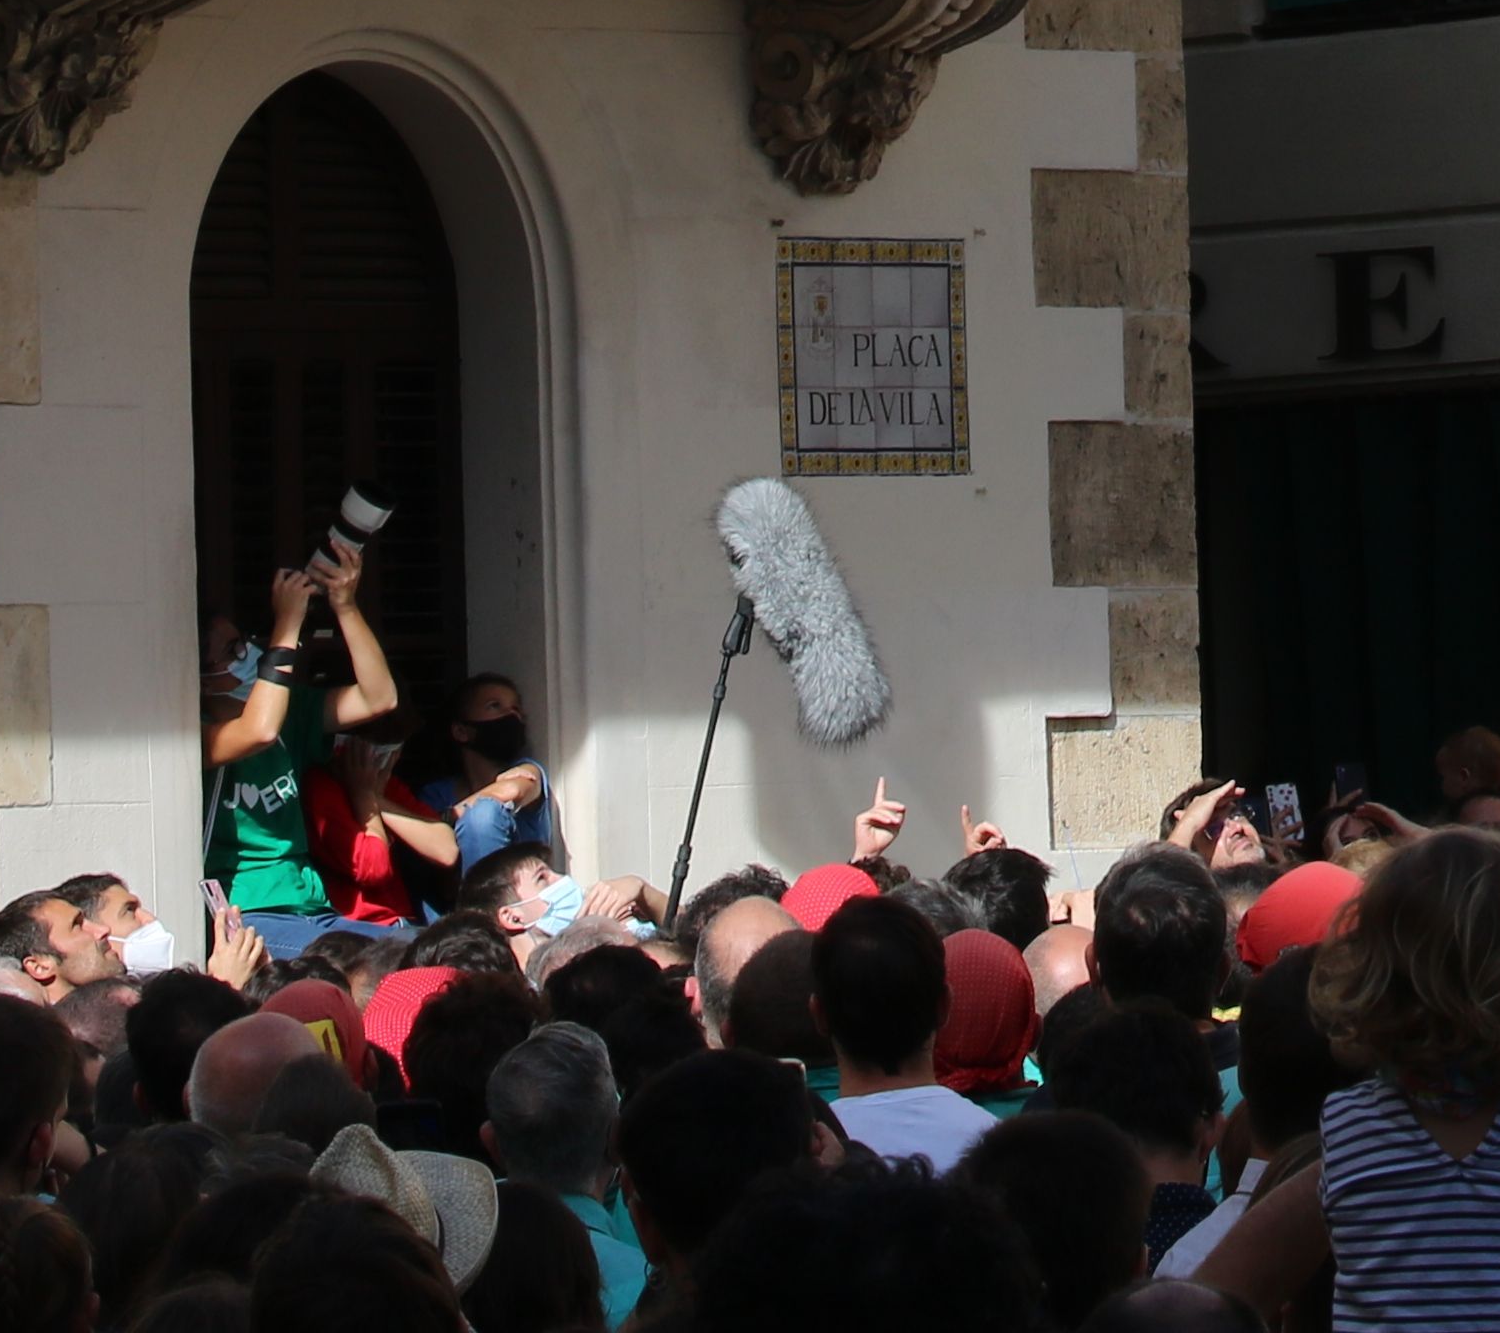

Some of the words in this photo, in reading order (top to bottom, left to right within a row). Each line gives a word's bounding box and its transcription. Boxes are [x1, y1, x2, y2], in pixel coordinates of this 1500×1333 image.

[852, 333, 942, 371] PLAÇA
[809, 391, 845, 426] DE
[849, 389, 876, 425] LA
[879, 391, 945, 426] VILA
